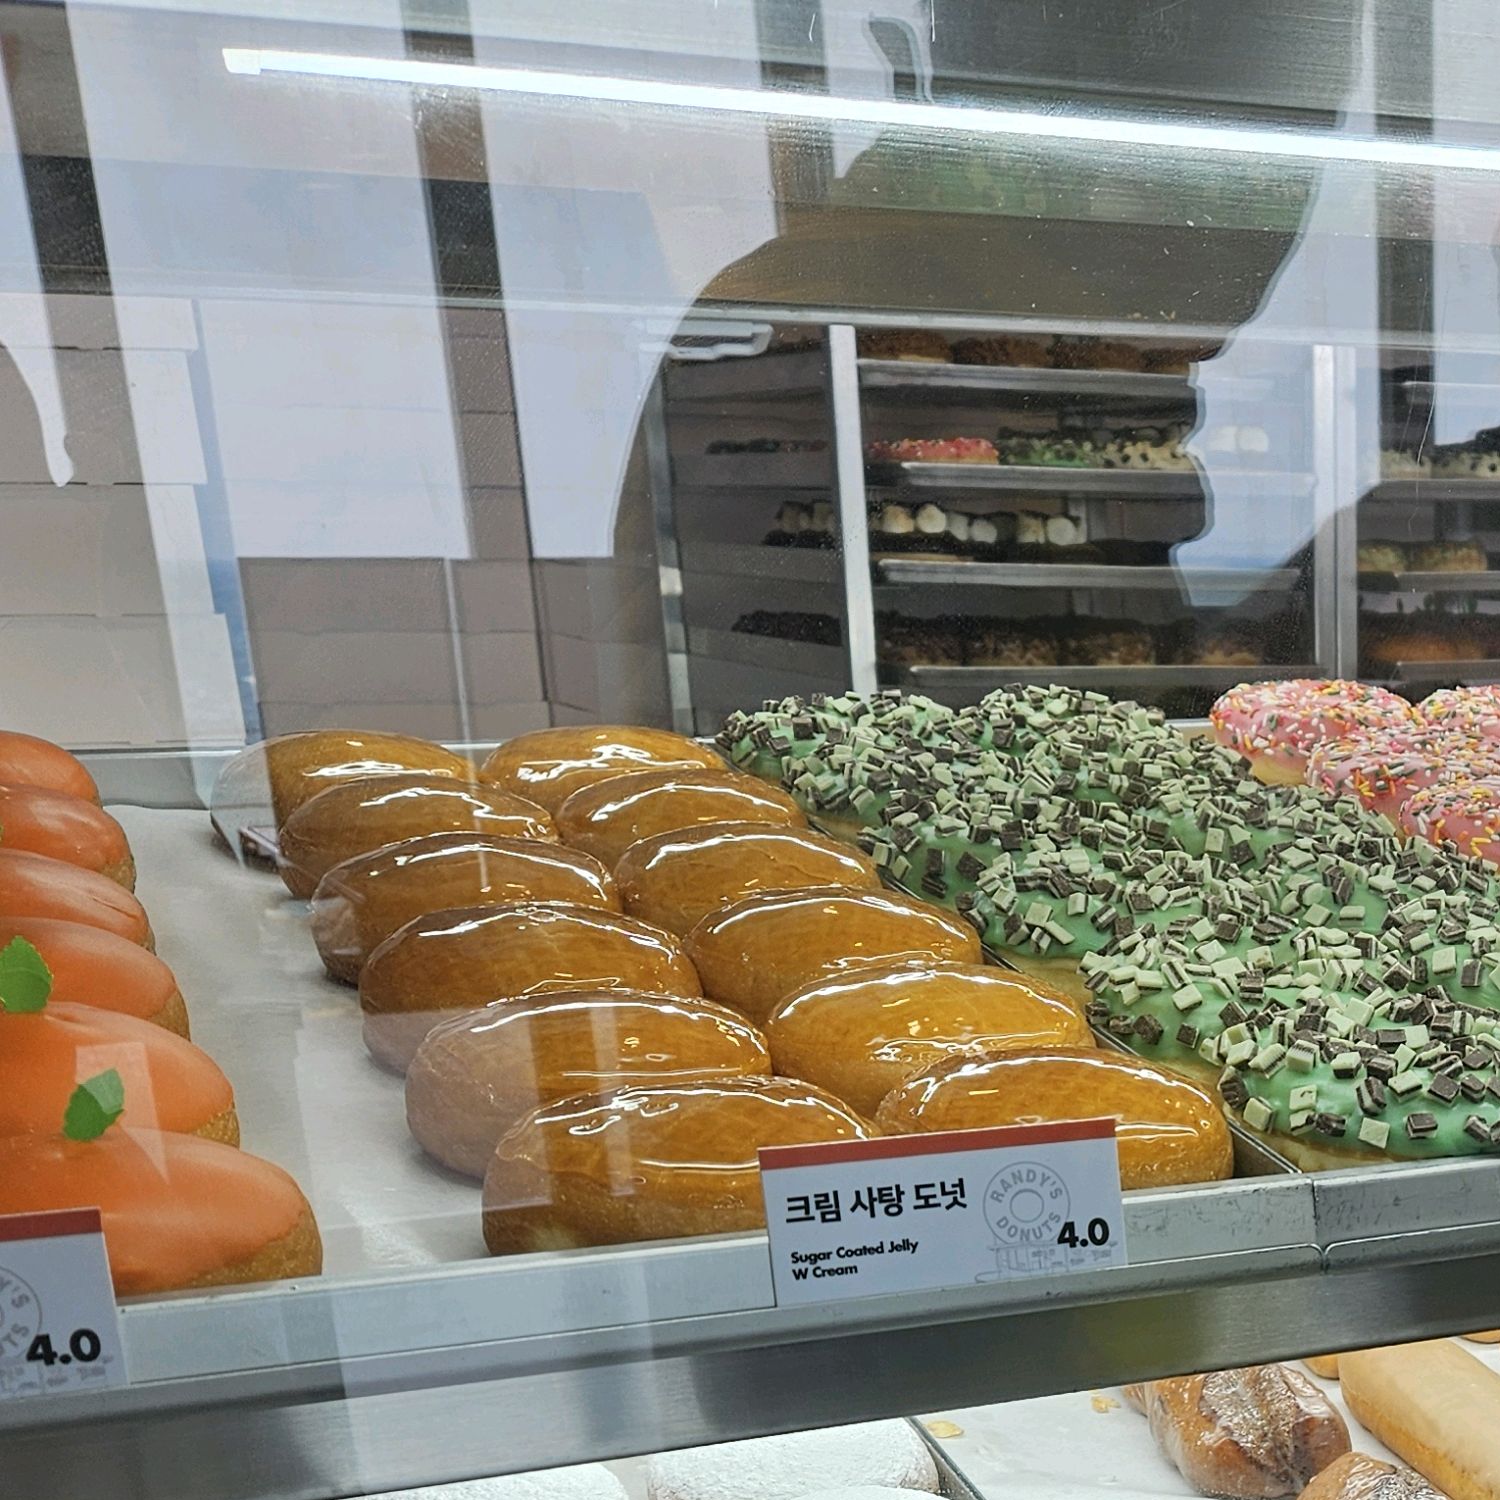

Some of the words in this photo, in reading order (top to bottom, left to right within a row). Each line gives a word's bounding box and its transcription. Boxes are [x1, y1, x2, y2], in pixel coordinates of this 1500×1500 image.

[785, 1190, 842, 1224] 크림
[850, 1184, 905, 1218] 사탕
[912, 1178, 968, 1211] 도넛
[990, 1169, 1064, 1203] RANDY'S
[996, 1211, 1062, 1243] DONUTS
[1057, 1218, 1110, 1249] 4.0
[790, 1249, 833, 1266] Sugar
[836, 1242, 885, 1260] Coated
[887, 1238, 919, 1256] Jelly
[792, 1268, 810, 1281] W
[812, 1264, 858, 1279] Cream
[26, 1328, 101, 1365] 4.0
